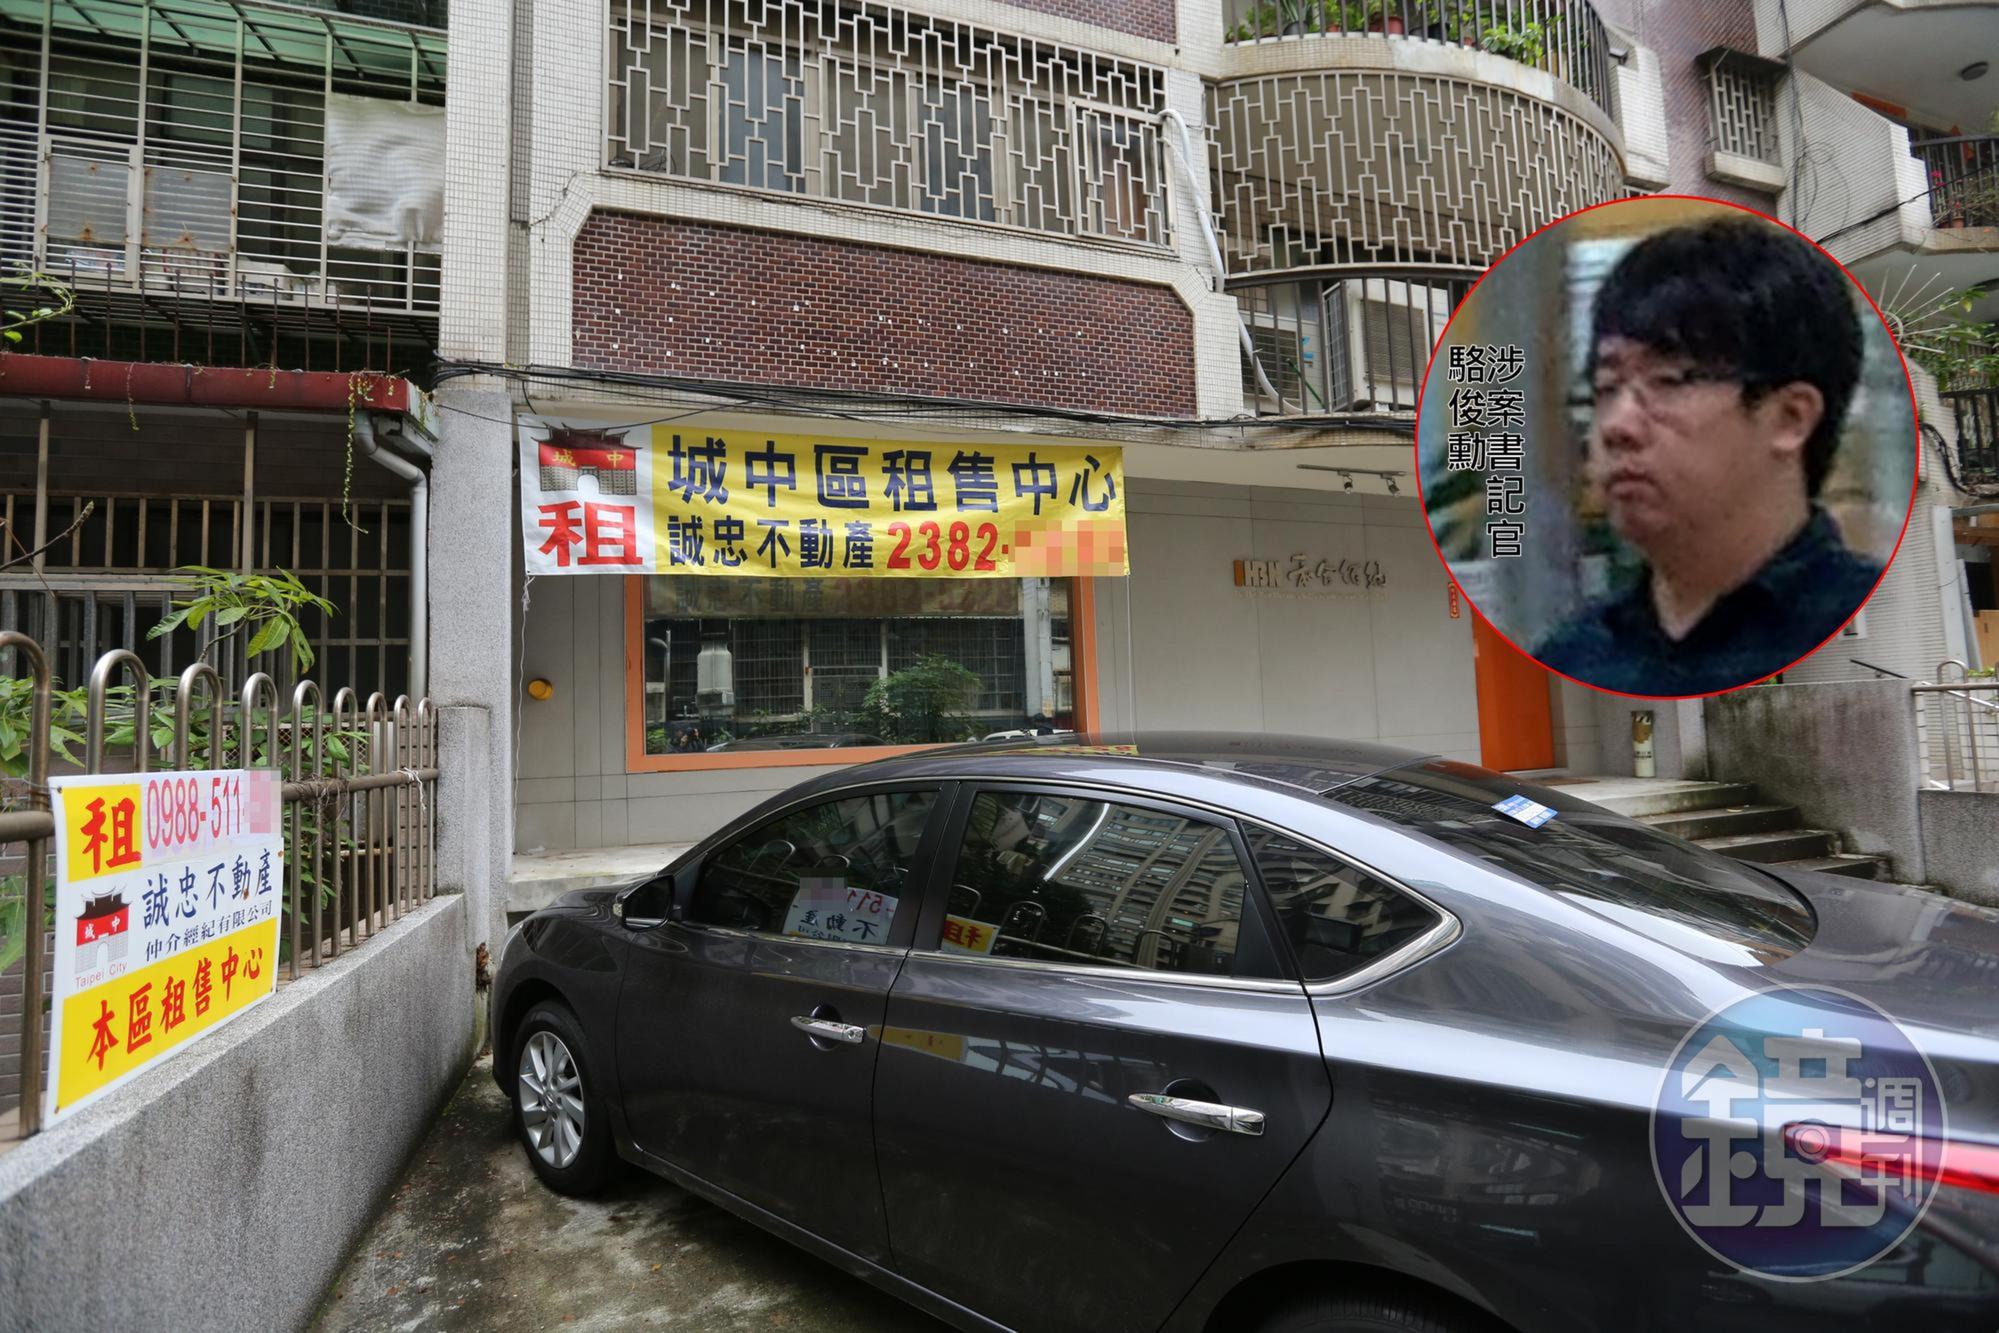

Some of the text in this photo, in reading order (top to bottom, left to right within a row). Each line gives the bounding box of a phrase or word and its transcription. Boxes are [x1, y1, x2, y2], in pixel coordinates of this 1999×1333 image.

[551, 449, 624, 467] 城中
[667, 434, 1116, 516] 城中區租售中心
[537, 500, 643, 567] 租
[667, 515, 874, 569] 誠忠不動產
[80, 797, 142, 874] 租
[141, 848, 272, 930] 誠忠不動產
[146, 899, 272, 962] 仲介經紀有限公司
[75, 961, 128, 989] Taipei City
[86, 945, 263, 1071] 本區租售中心
